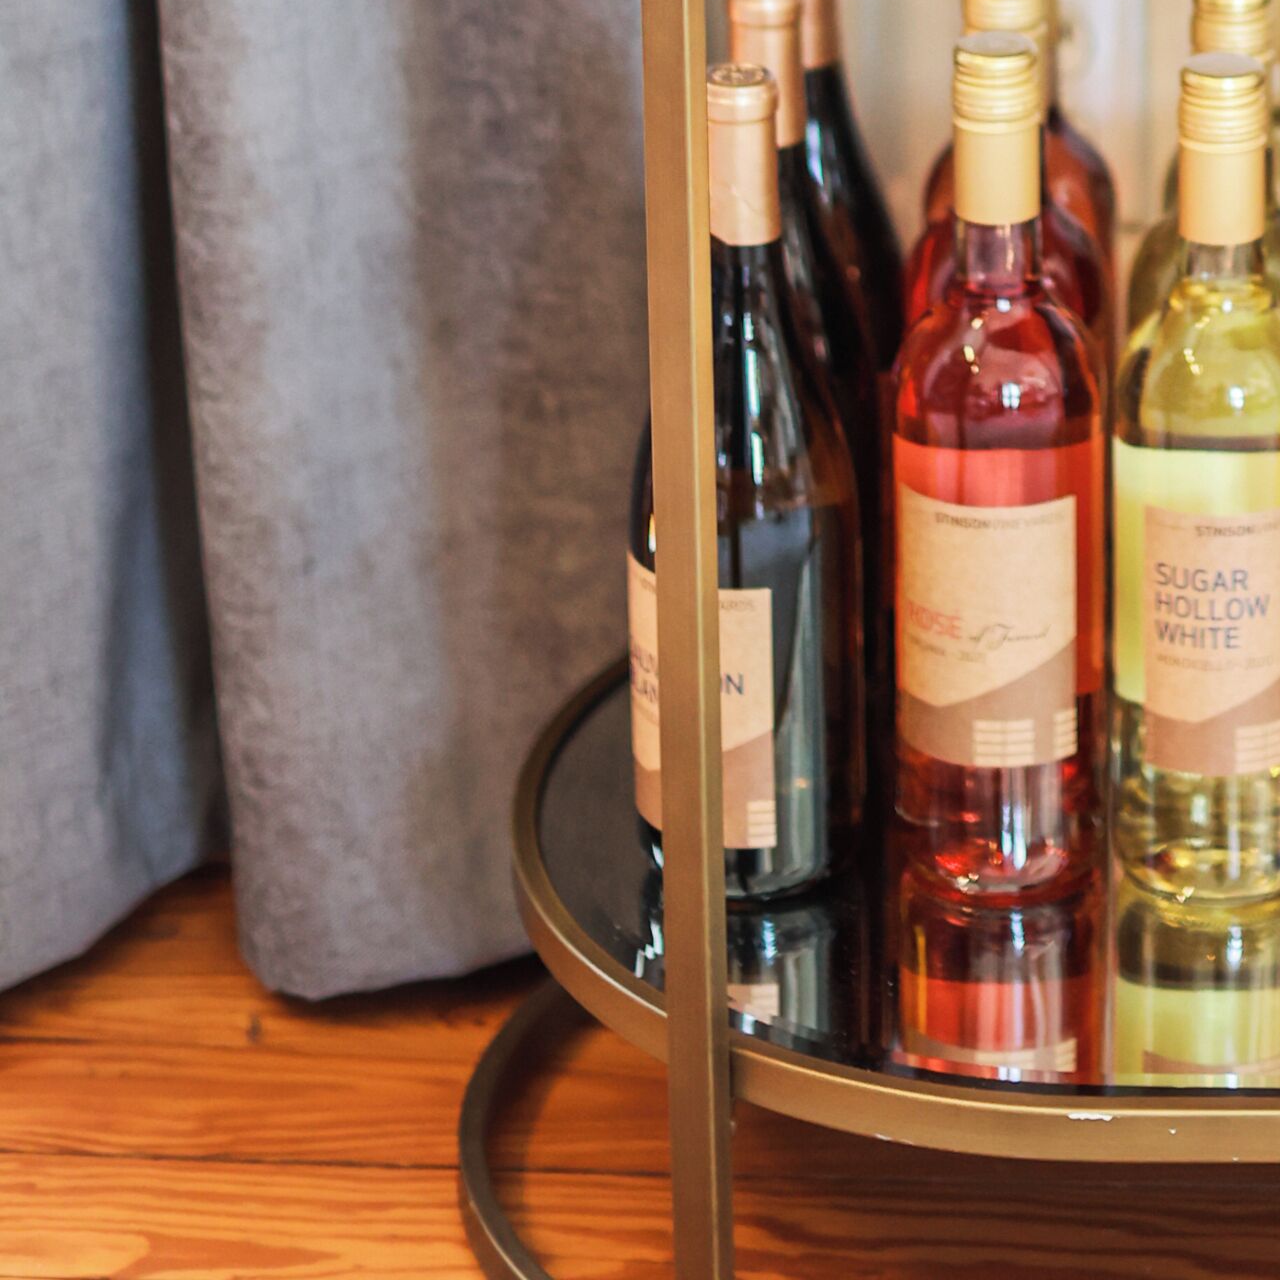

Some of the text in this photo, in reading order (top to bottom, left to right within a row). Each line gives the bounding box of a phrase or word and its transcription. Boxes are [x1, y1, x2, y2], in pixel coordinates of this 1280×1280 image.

[1155, 561, 1249, 593] SUGAR
[1155, 590, 1271, 621] HOLLOW
[1155, 619, 1241, 650] WHITE
